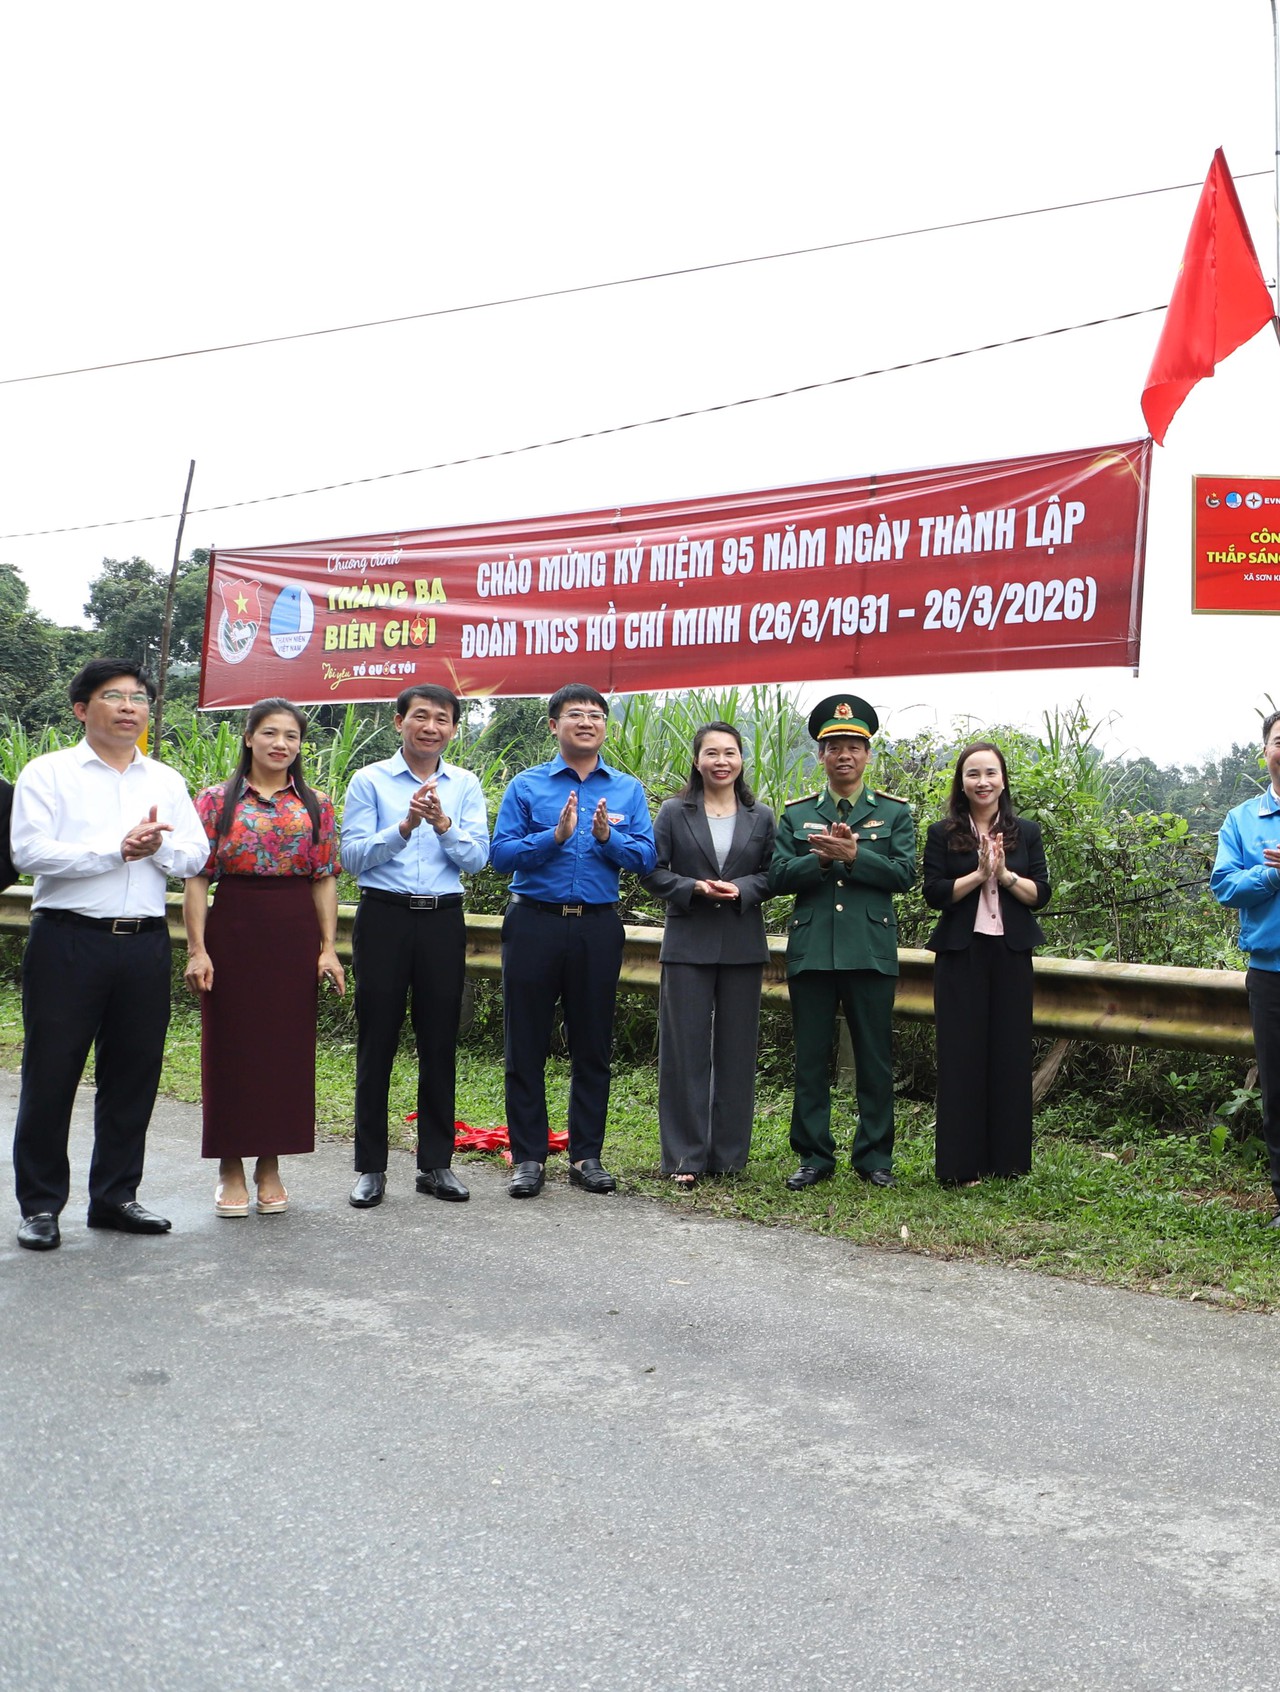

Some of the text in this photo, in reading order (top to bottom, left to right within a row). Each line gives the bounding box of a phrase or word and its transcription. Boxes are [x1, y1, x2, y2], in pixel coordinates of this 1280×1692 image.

[476, 553, 532, 598] CHÀO
[538, 547, 607, 592] MỪNG
[649, 535, 715, 588] NIỆM
[721, 535, 754, 576] 95
[762, 524, 826, 572] NĂM
[834, 513, 911, 565] NGÀY
[918, 505, 1017, 558] THÀNH
[1025, 494, 1086, 555] LẬP
[1207, 544, 1247, 563] THẮP
[326, 577, 448, 611] THÁNG BA
[461, 615, 517, 659] ĐOÀN
[523, 616, 579, 655] TNCS
[585, 601, 617, 651] HỒ
[624, 603, 667, 649] CHÍ
[672, 604, 742, 646] MINH
[748, 593, 890, 644] (26/3/1931
[923, 575, 1098, 633] 26/3/2026)
[324, 618, 377, 651] BIÊN
[353, 661, 366, 676] TỔ
[398, 661, 416, 675] TÔI
